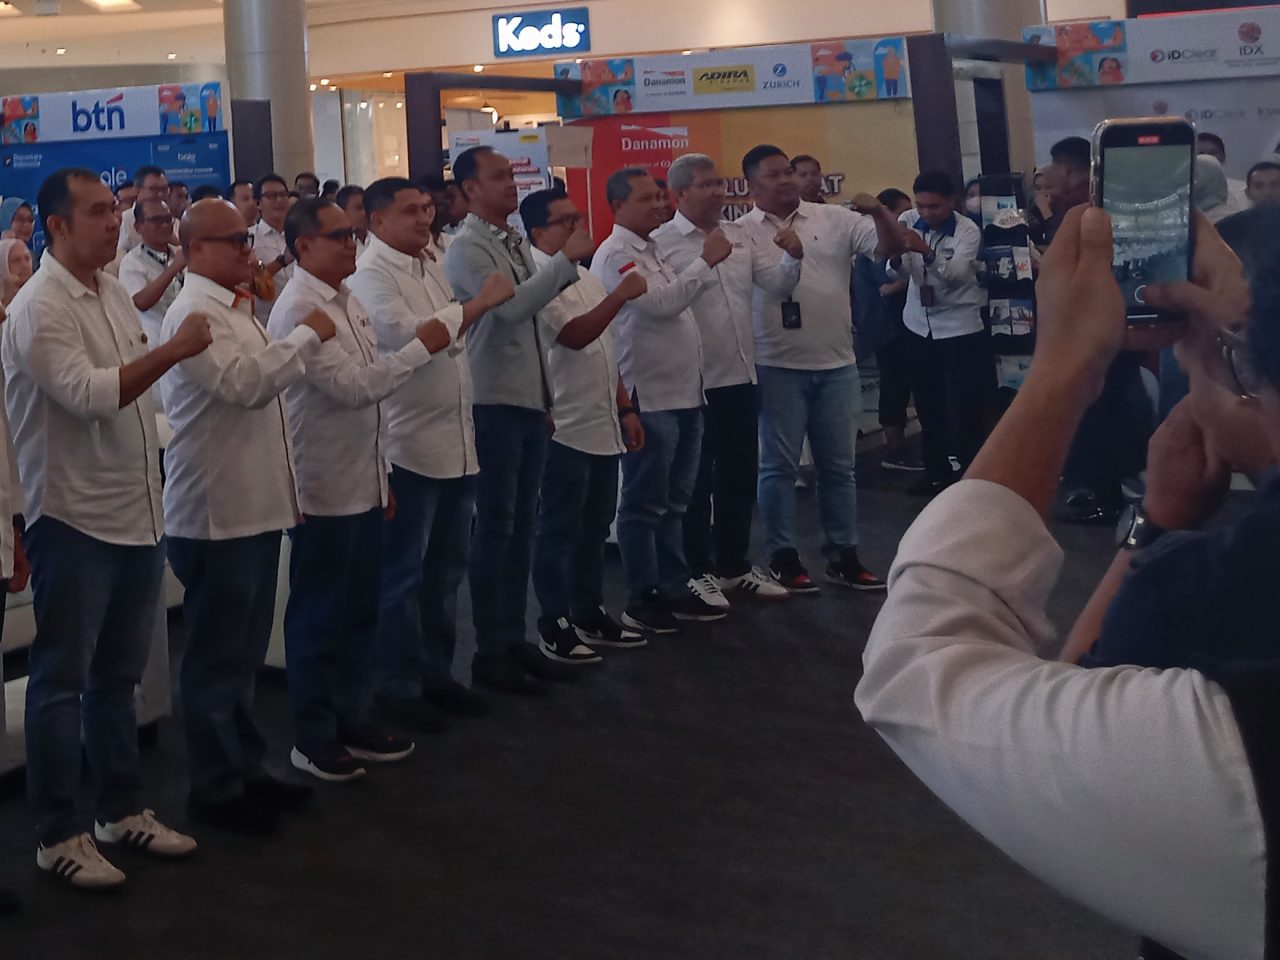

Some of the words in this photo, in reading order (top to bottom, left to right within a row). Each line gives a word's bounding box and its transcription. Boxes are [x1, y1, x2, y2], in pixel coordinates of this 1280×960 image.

[498, 13, 581, 52] Keds
[72, 94, 125, 132] btn
[622, 137, 689, 151] Danamon
